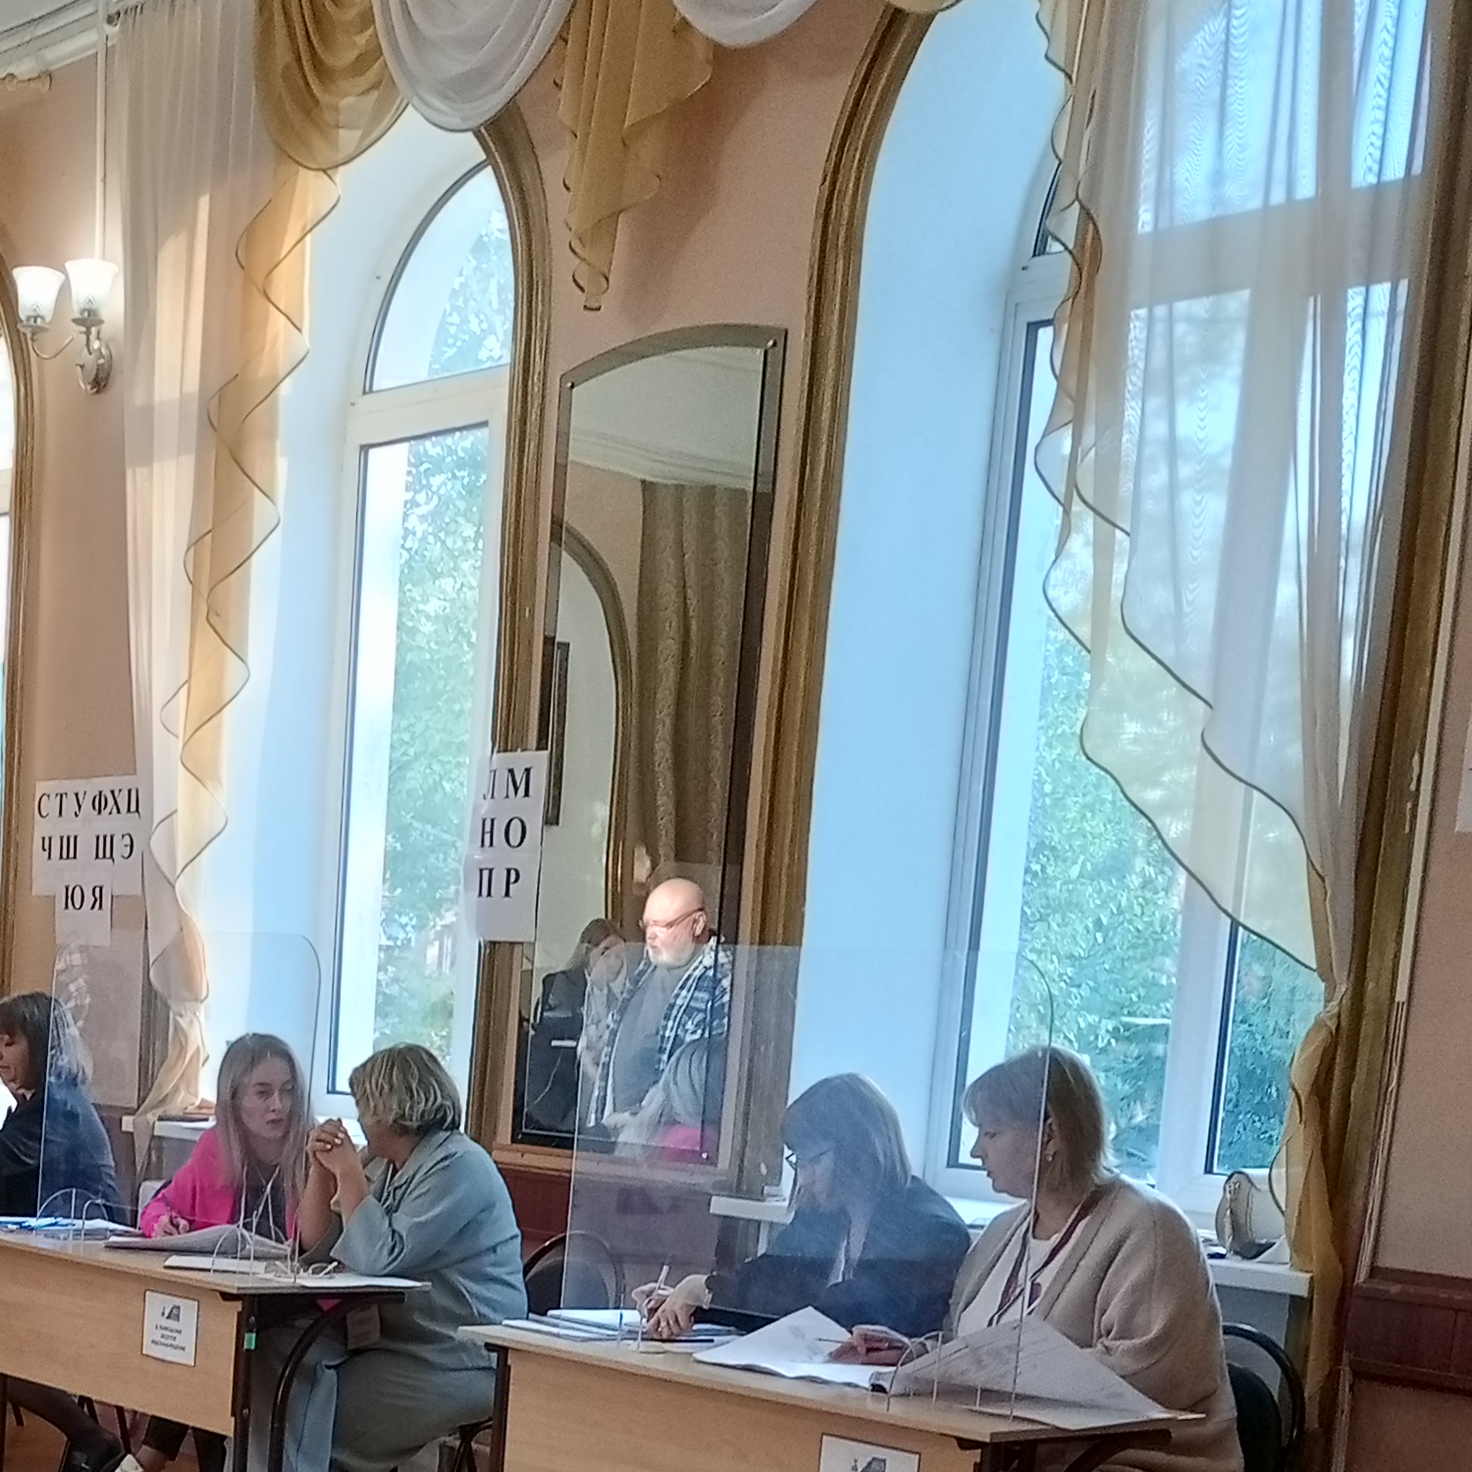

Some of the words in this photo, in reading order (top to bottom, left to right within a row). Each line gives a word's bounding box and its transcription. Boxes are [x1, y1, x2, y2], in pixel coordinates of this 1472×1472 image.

[37, 787, 141, 819] СТУФХЦ
[480, 816, 528, 849] НО
[63, 883, 105, 911] ЮЯ
[477, 866, 521, 898] ПР
